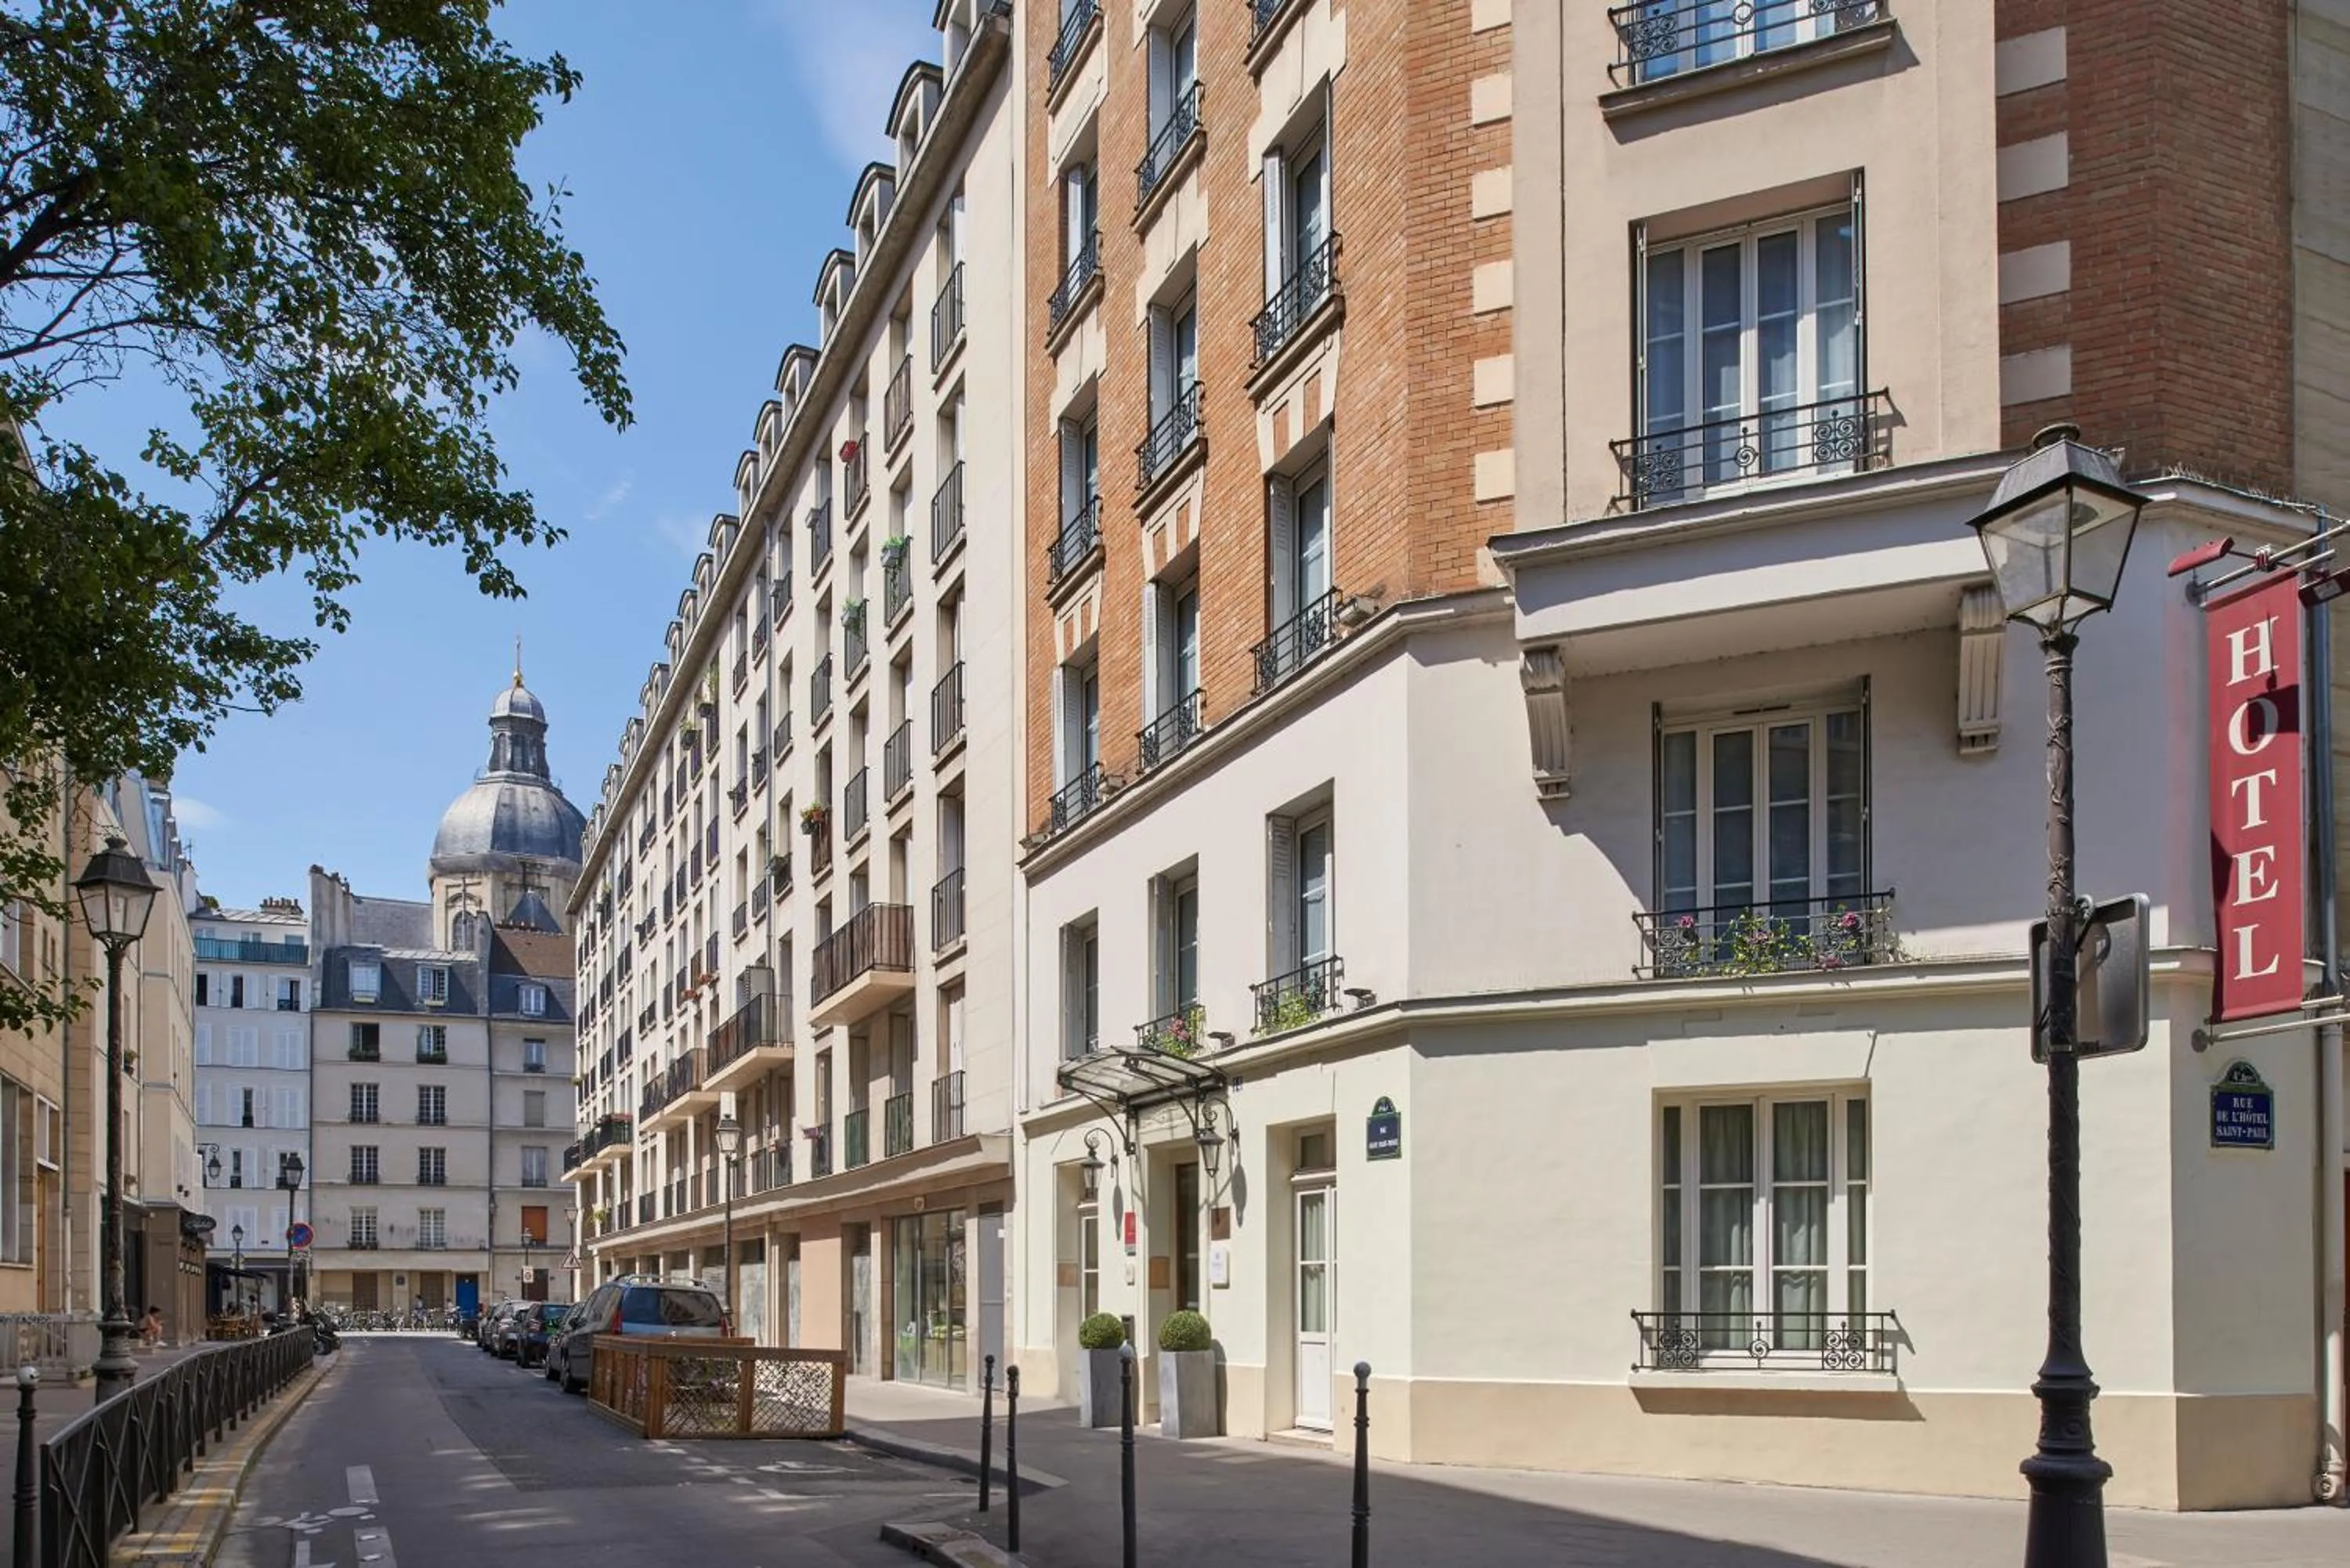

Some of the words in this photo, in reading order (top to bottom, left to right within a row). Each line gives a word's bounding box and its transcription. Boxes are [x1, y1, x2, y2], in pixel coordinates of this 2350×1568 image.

[2225, 615, 2280, 981] HOTEL
[2232, 1097, 2254, 1109] RUE
[2216, 1111, 2229, 1122] DE
